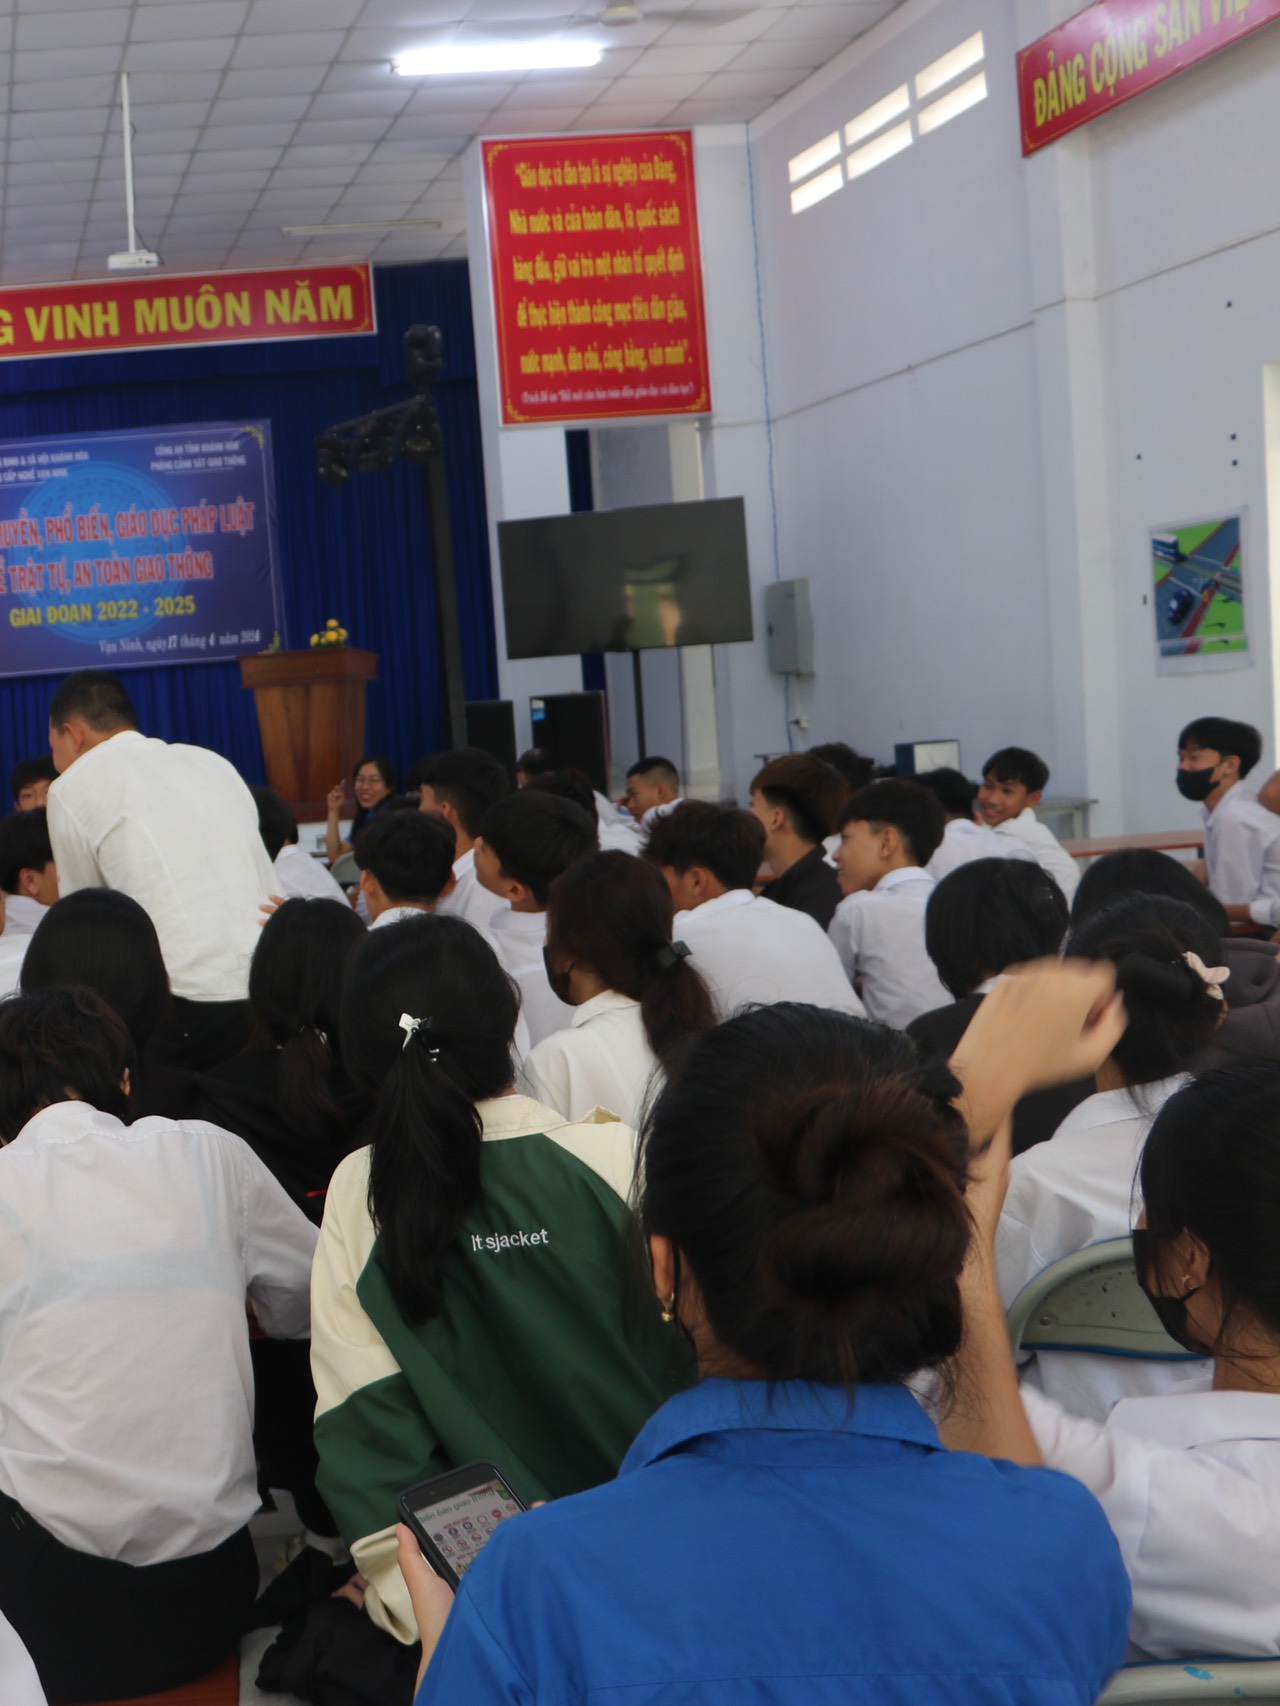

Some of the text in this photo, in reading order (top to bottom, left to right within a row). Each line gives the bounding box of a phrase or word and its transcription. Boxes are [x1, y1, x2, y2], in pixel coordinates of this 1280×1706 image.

[24, 300, 120, 343] VINH
[134, 284, 251, 335] MUÔN
[265, 279, 354, 325] NĂM
[45, 501, 73, 544] PHỔ
[116, 503, 148, 539] GIÁO
[151, 507, 179, 542] DỤC
[181, 498, 218, 535] PHÁP
[220, 495, 255, 537] LUẬT
[8, 557, 44, 597] TRẬT
[74, 560, 93, 588] AN
[94, 550, 131, 585] TOÀN
[134, 555, 165, 583] GIAO
[168, 545, 214, 580] THÔNG
[9, 607, 42, 628] GIAI
[47, 603, 93, 625] ĐOẠN
[97, 599, 138, 620] 2022
[155, 595, 196, 616] 2025
